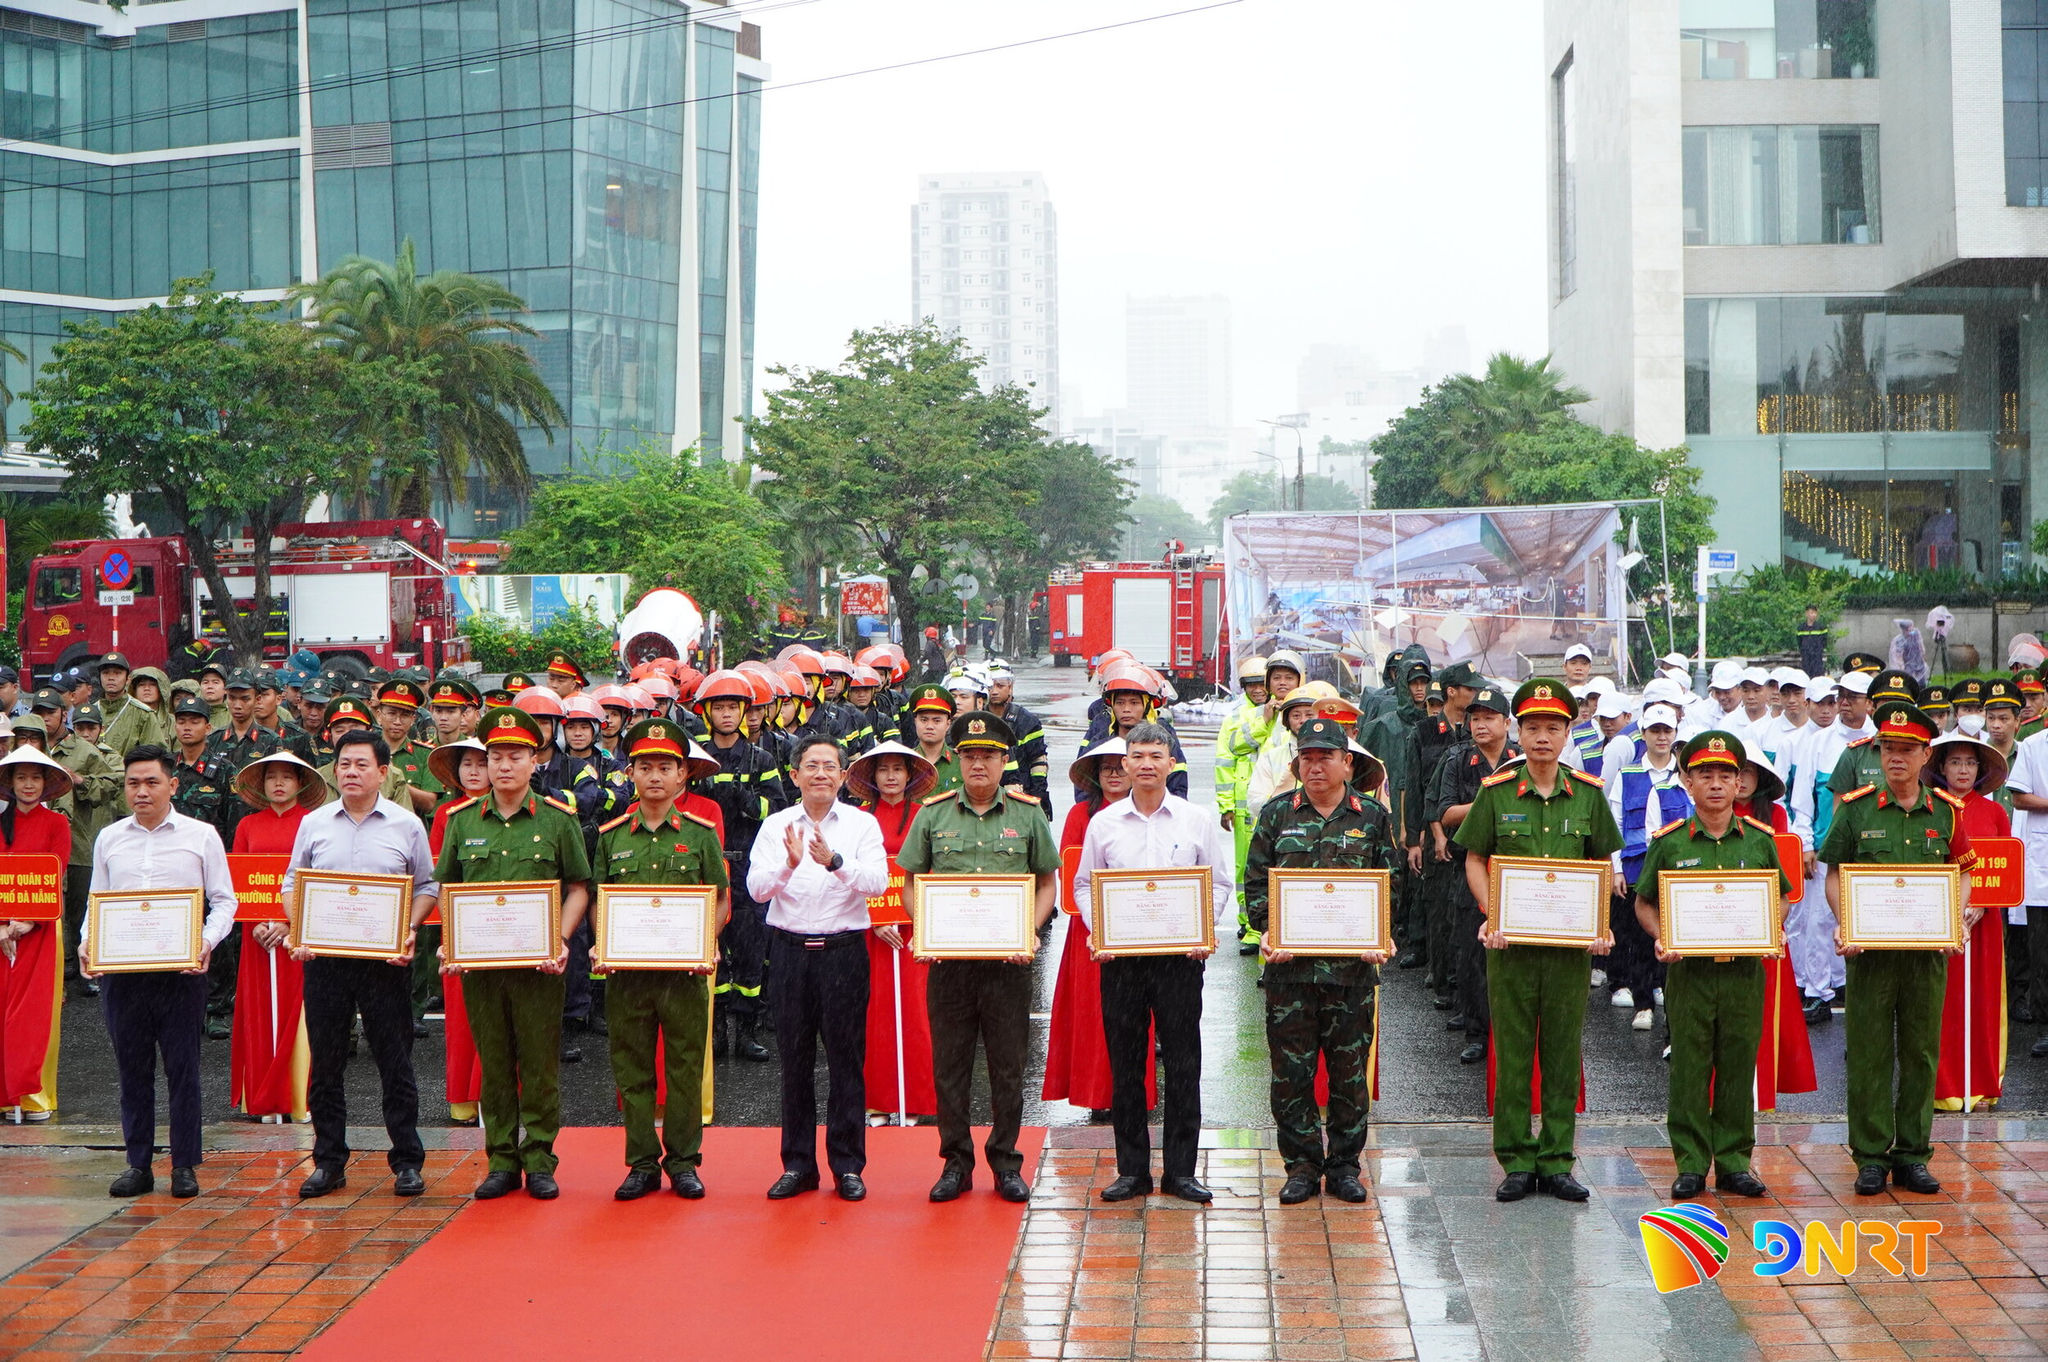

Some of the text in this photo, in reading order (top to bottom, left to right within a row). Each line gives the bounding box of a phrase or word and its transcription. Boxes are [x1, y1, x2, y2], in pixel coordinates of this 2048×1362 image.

[1988, 857, 2007, 869] 199
[17, 872, 41, 886] QUÂN
[43, 873, 57, 887] SỰ
[248, 872, 287, 885] CÔNG A
[1985, 876, 2000, 887] AN
[17, 890, 29, 903] ĐÀ
[32, 888, 57, 903] NẴNG
[234, 890, 284, 903] PHƯỜNG A
[887, 893, 901, 907] VÀ
